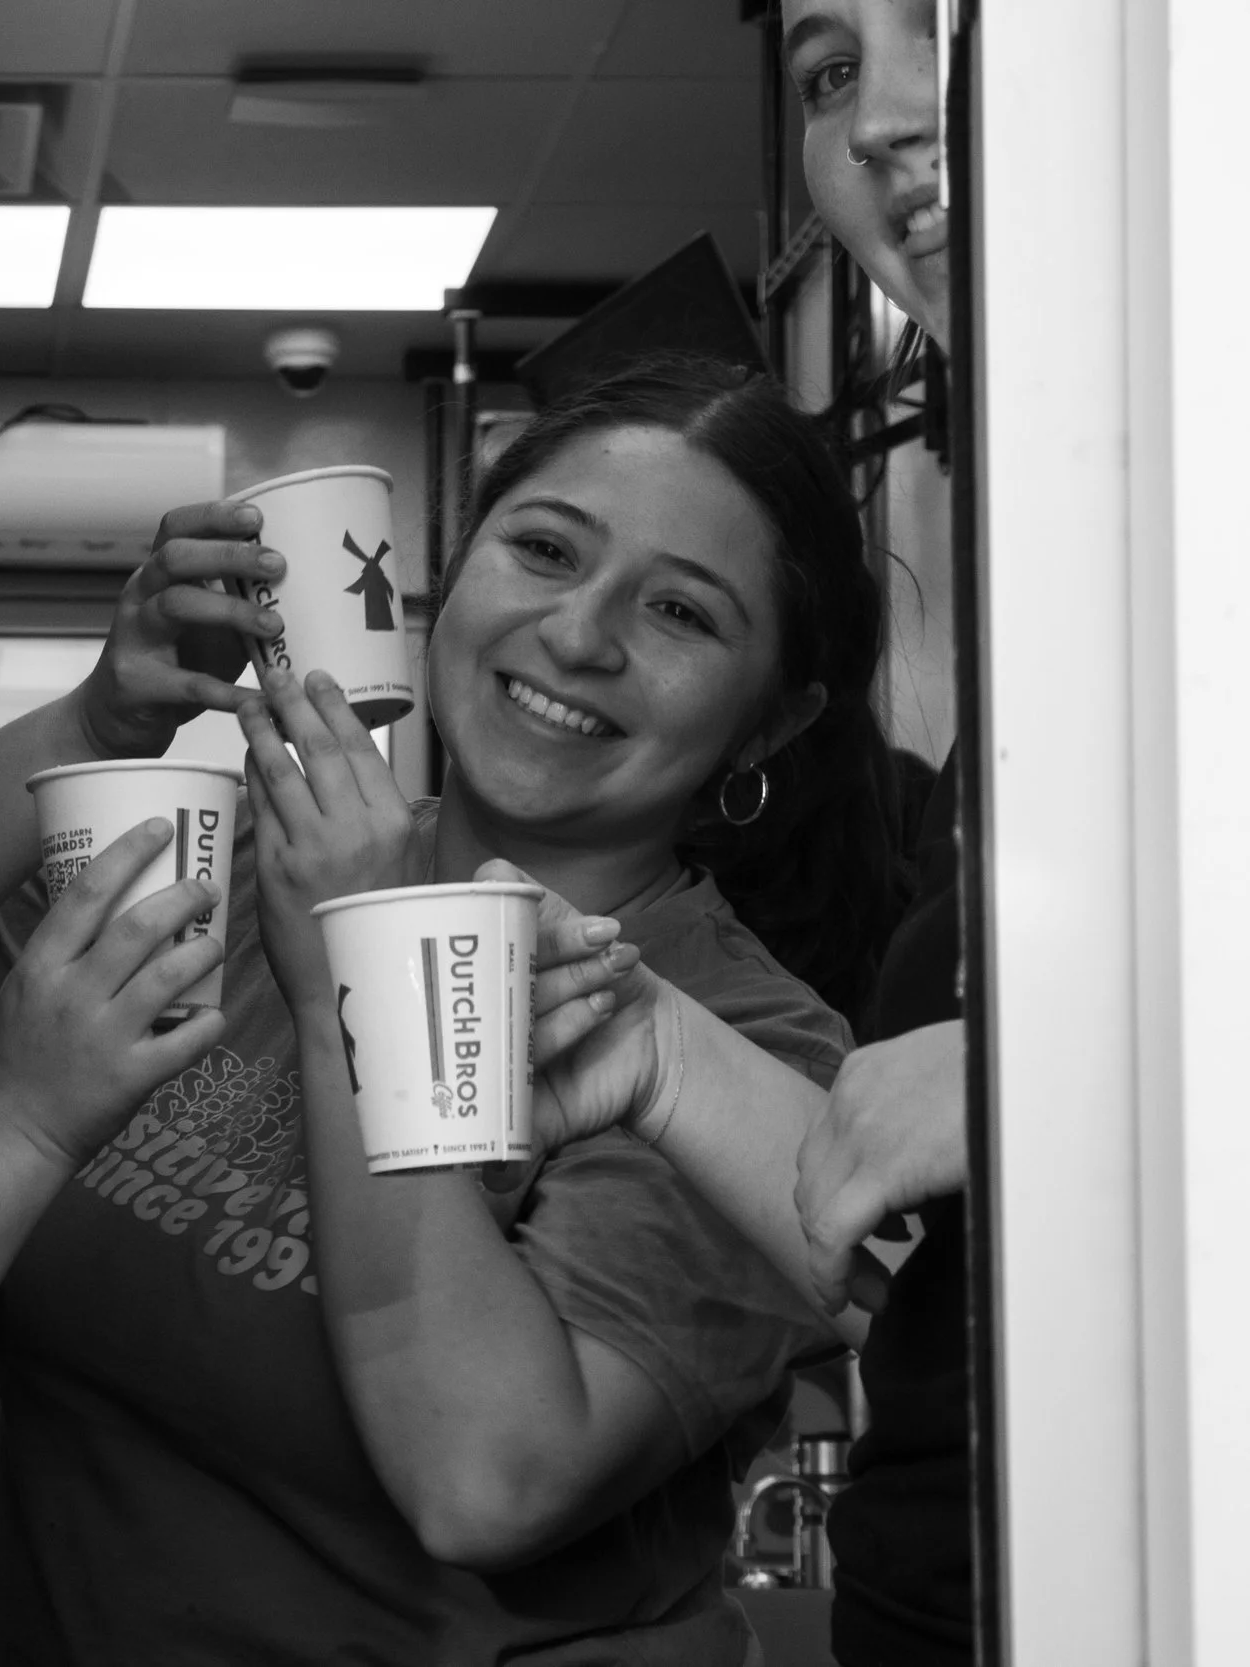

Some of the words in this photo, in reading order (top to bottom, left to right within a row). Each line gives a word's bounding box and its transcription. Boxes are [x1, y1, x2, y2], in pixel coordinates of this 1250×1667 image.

[58, 832, 67, 840] TO
[196, 808, 220, 880] DUTC
[449, 935, 481, 1033] DUTCH
[454, 1041, 481, 1118] BROS
[113, 1114, 275, 1217] sitive
[74, 1146, 209, 1235] ince
[203, 1219, 320, 1296] 199
